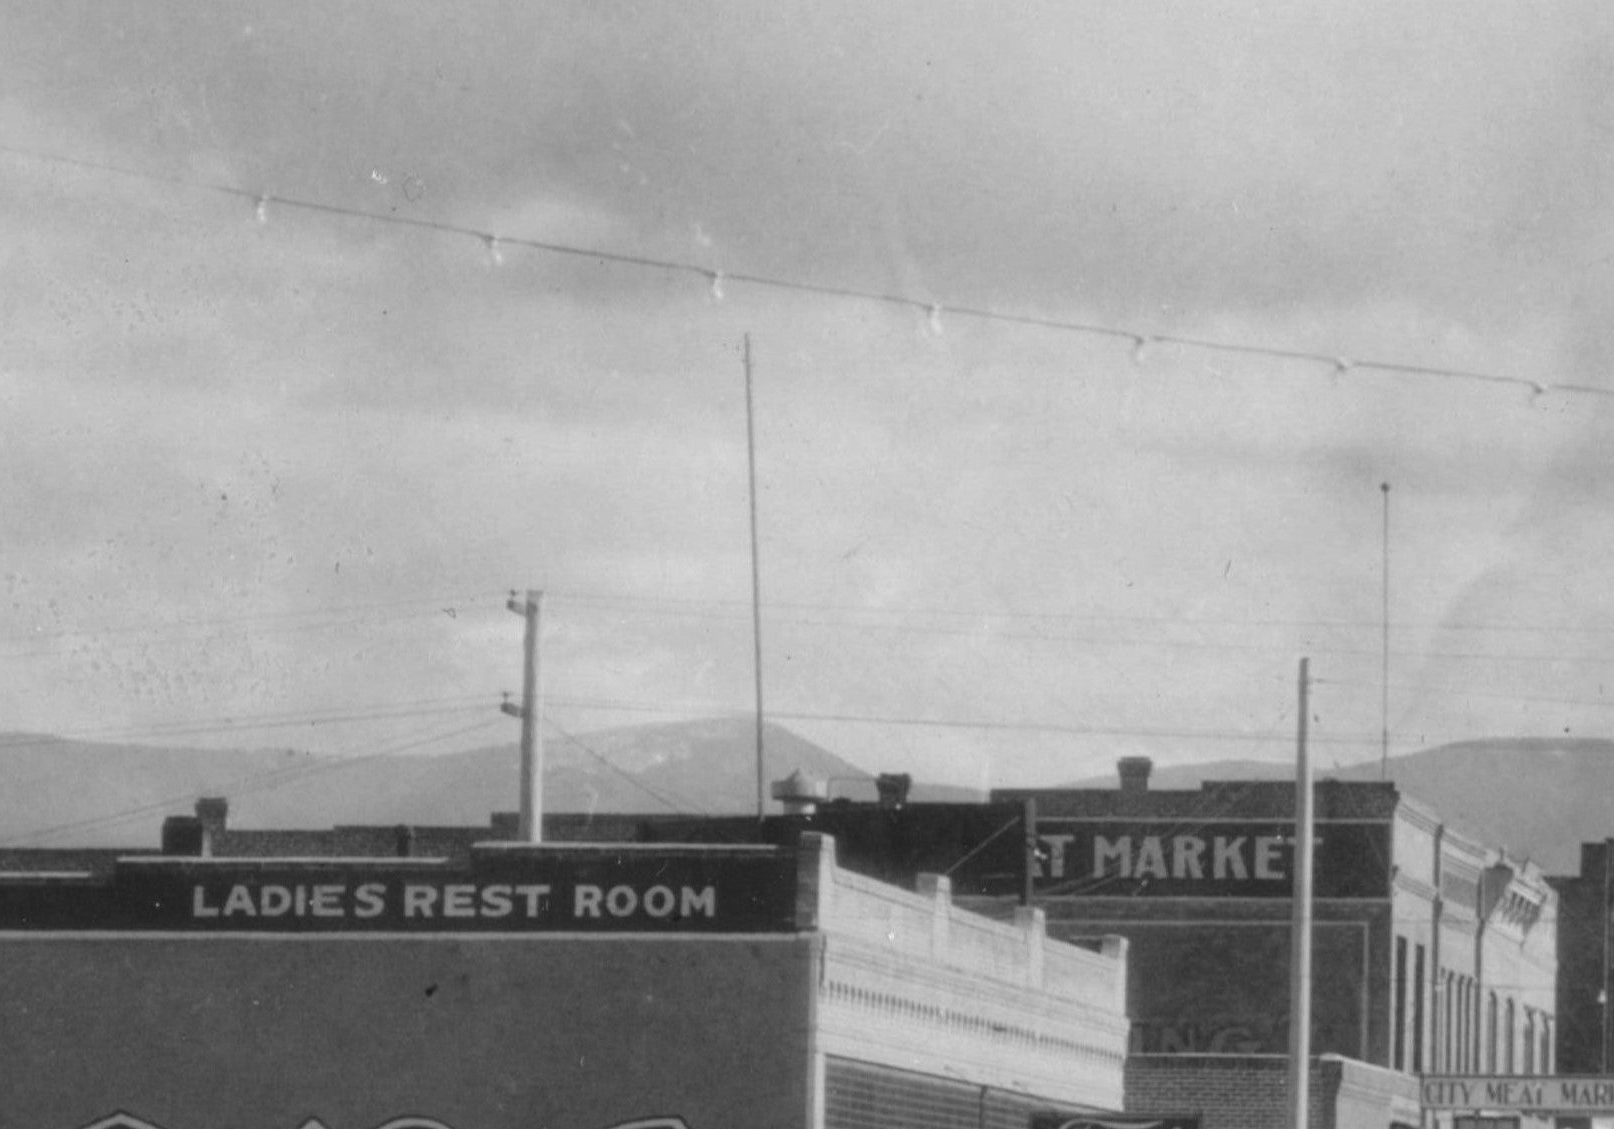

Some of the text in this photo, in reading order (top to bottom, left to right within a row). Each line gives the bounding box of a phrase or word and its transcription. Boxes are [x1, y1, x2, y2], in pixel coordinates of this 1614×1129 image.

[192, 883, 716, 918] LADIES REST ROOM
[1425, 1082, 1474, 1105] CITY
[1485, 1082, 1545, 1105] MEAT
